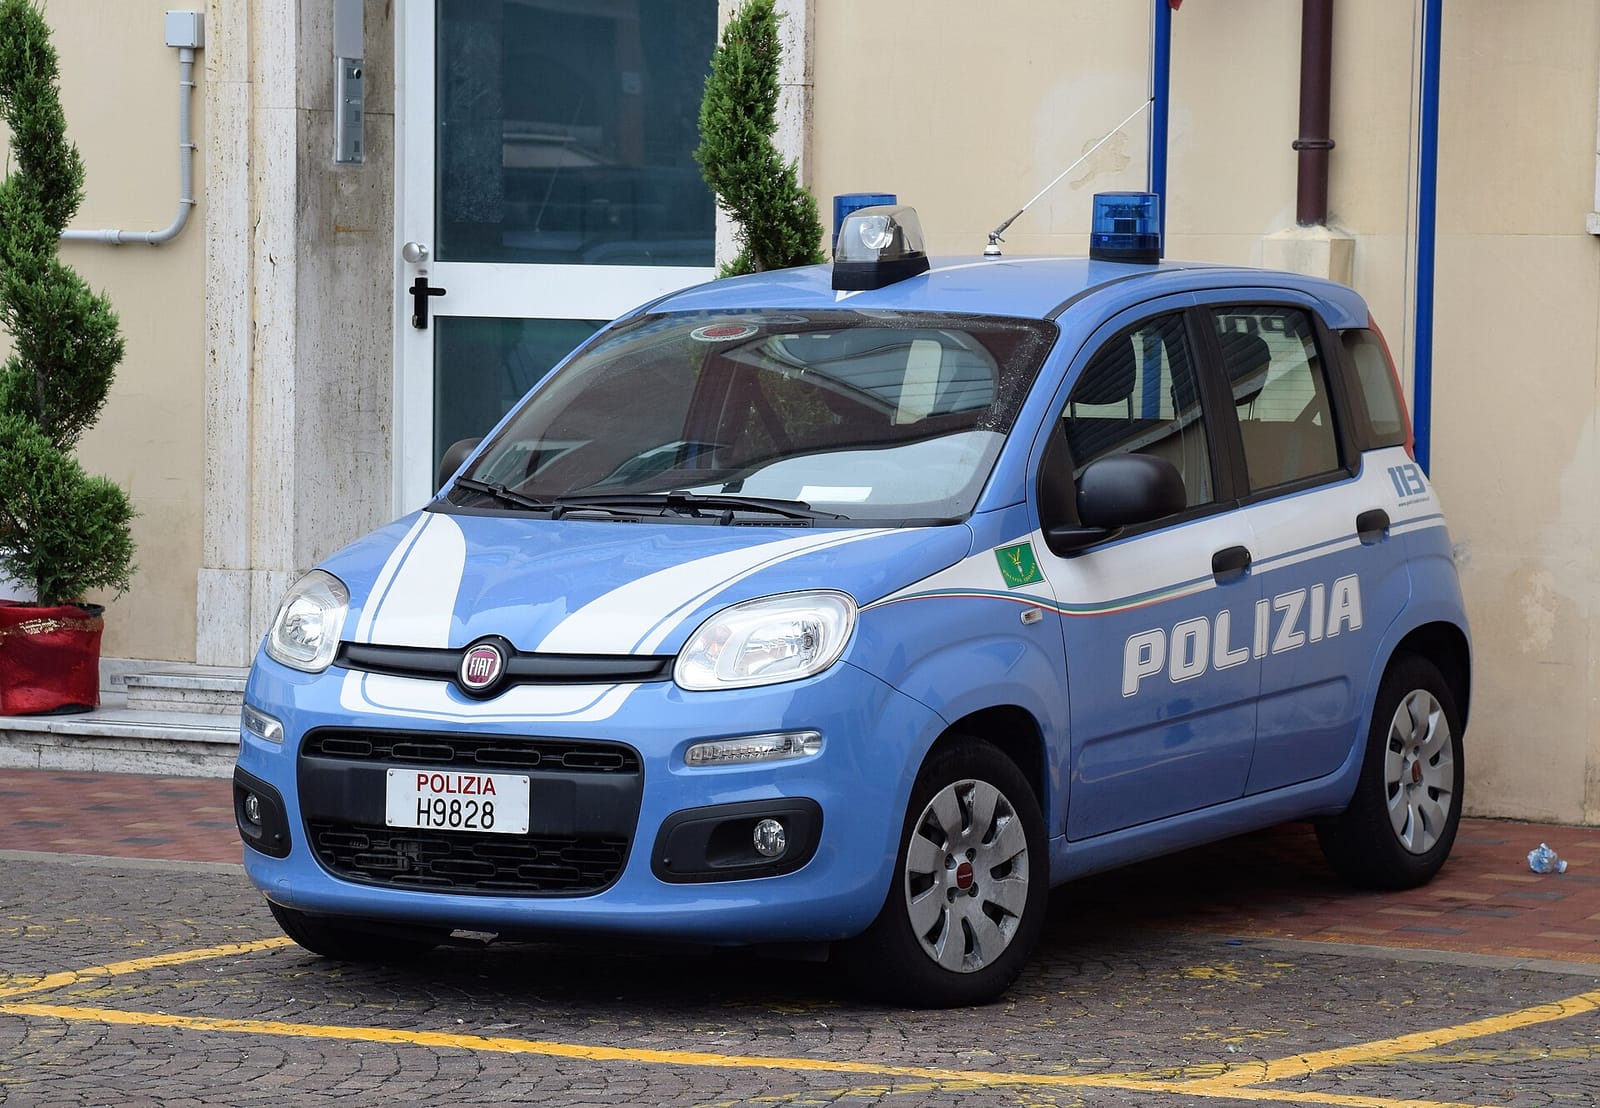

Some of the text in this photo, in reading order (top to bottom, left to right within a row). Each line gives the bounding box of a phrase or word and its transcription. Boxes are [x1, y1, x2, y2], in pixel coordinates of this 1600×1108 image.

[1387, 464, 1425, 497] 113
[1122, 573, 1363, 698] POLIZIA
[469, 657, 494, 677] FIAT
[416, 774, 496, 796] POLIZIA
[416, 797, 495, 830] H9828
